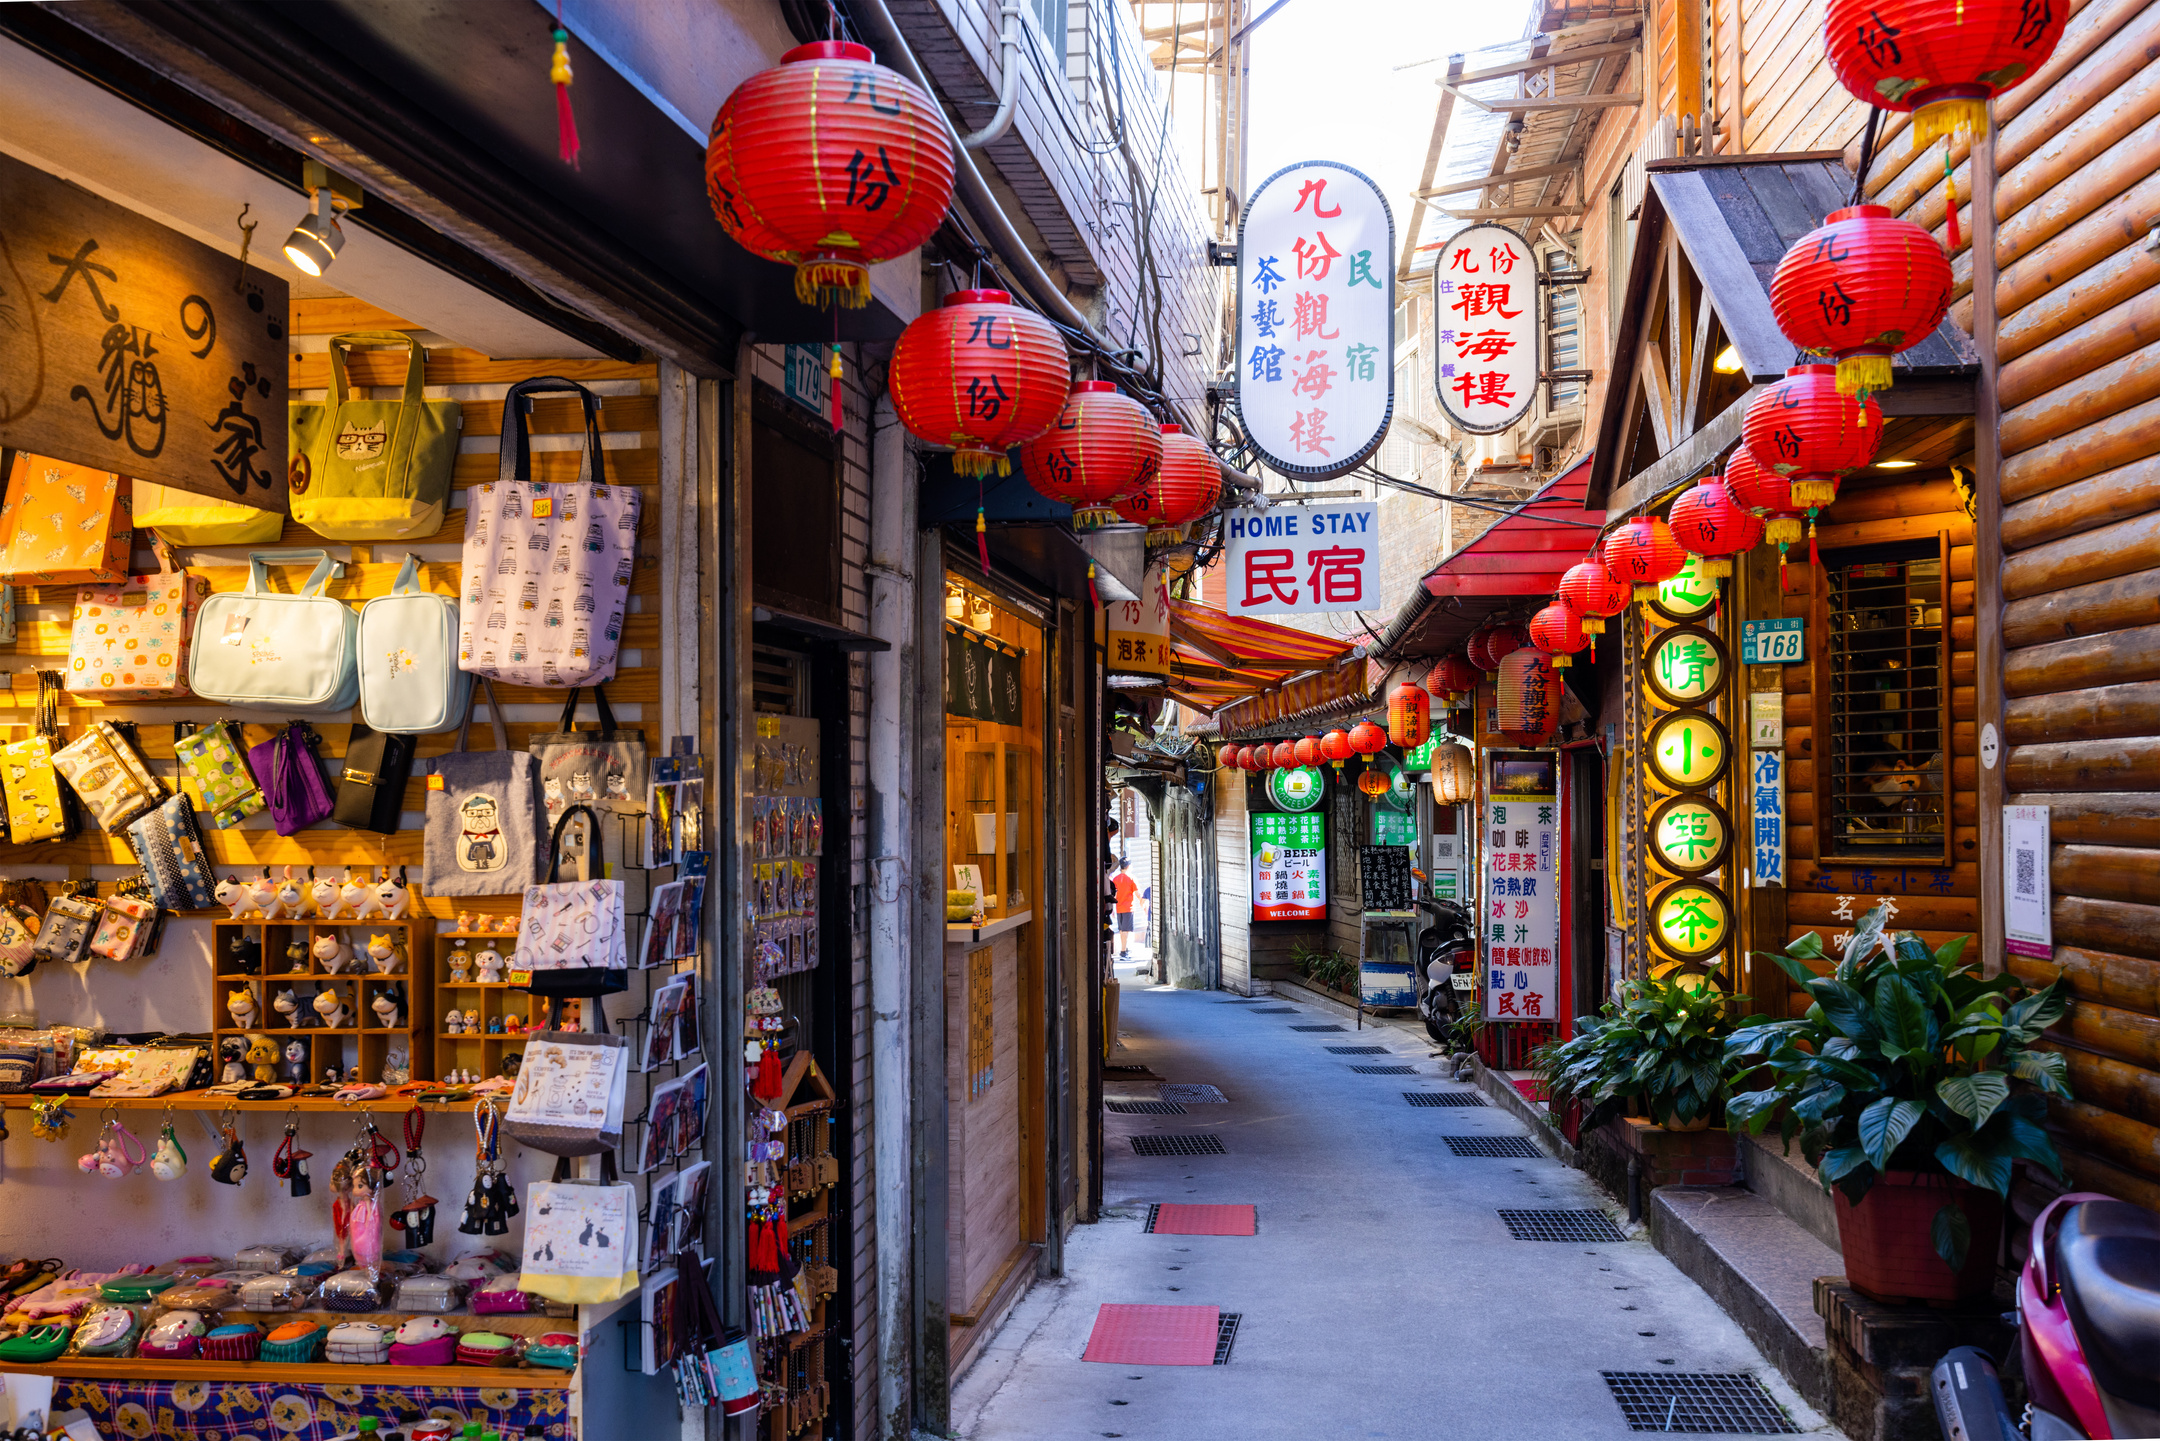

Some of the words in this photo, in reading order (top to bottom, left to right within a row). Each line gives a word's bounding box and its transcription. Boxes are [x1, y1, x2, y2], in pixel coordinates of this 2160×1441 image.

[843, 69, 902, 211] 九份
[1450, 243, 1520, 274] 九份
[1812, 232, 1855, 327] 九份
[1247, 255, 1287, 382] 茶藝館
[1289, 179, 1342, 458] 九份觀海樓
[1346, 250, 1382, 382] 民宿
[1451, 282, 1523, 408] 觀海樓
[798, 355, 820, 401] 179
[966, 315, 1010, 422] 九份
[1771, 385, 1803, 459] 九份
[1231, 515, 1298, 538] HOME
[1312, 512, 1370, 534] STAY
[1696, 490, 1719, 543] 九份
[1629, 531, 1649, 575] 九份
[1241, 545, 1366, 607] 民宿
[1118, 638, 1146, 662] 泡茶
[1761, 634, 1798, 658] 168
[1521, 657, 1552, 736] 九份觀海樓
[1276, 787, 1300, 808] COFFEE
[1308, 787, 1320, 802] TEA
[1255, 816, 1264, 836] 泡茶
[1266, 816, 1275, 836] 咖啡
[1288, 816, 1298, 835] 冰沙
[1492, 805, 1552, 825] 泡茶
[1754, 754, 1782, 879] 冷氣開放
[1277, 816, 1287, 845] 冷熱飲
[1300, 816, 1309, 844] 花果茶
[1311, 816, 1320, 844] 鮮果汁
[1492, 829, 1529, 848] 咖啡
[1283, 849, 1318, 858] BEER
[1284, 859, 1310, 868] ビール
[1492, 852, 1537, 872] 花果茶
[1259, 871, 1272, 900] 簡餐
[1292, 871, 1305, 900] 火鍋
[1307, 869, 1320, 899] 素食餐
[1492, 877, 1537, 896] 冷熱飲
[1270, 909, 1310, 918] WELCOME
[1491, 900, 1529, 919] 冰沙
[1491, 924, 1528, 943] 果汁
[1491, 970, 1528, 990] 點心
[1497, 991, 1544, 1017] 民宿
